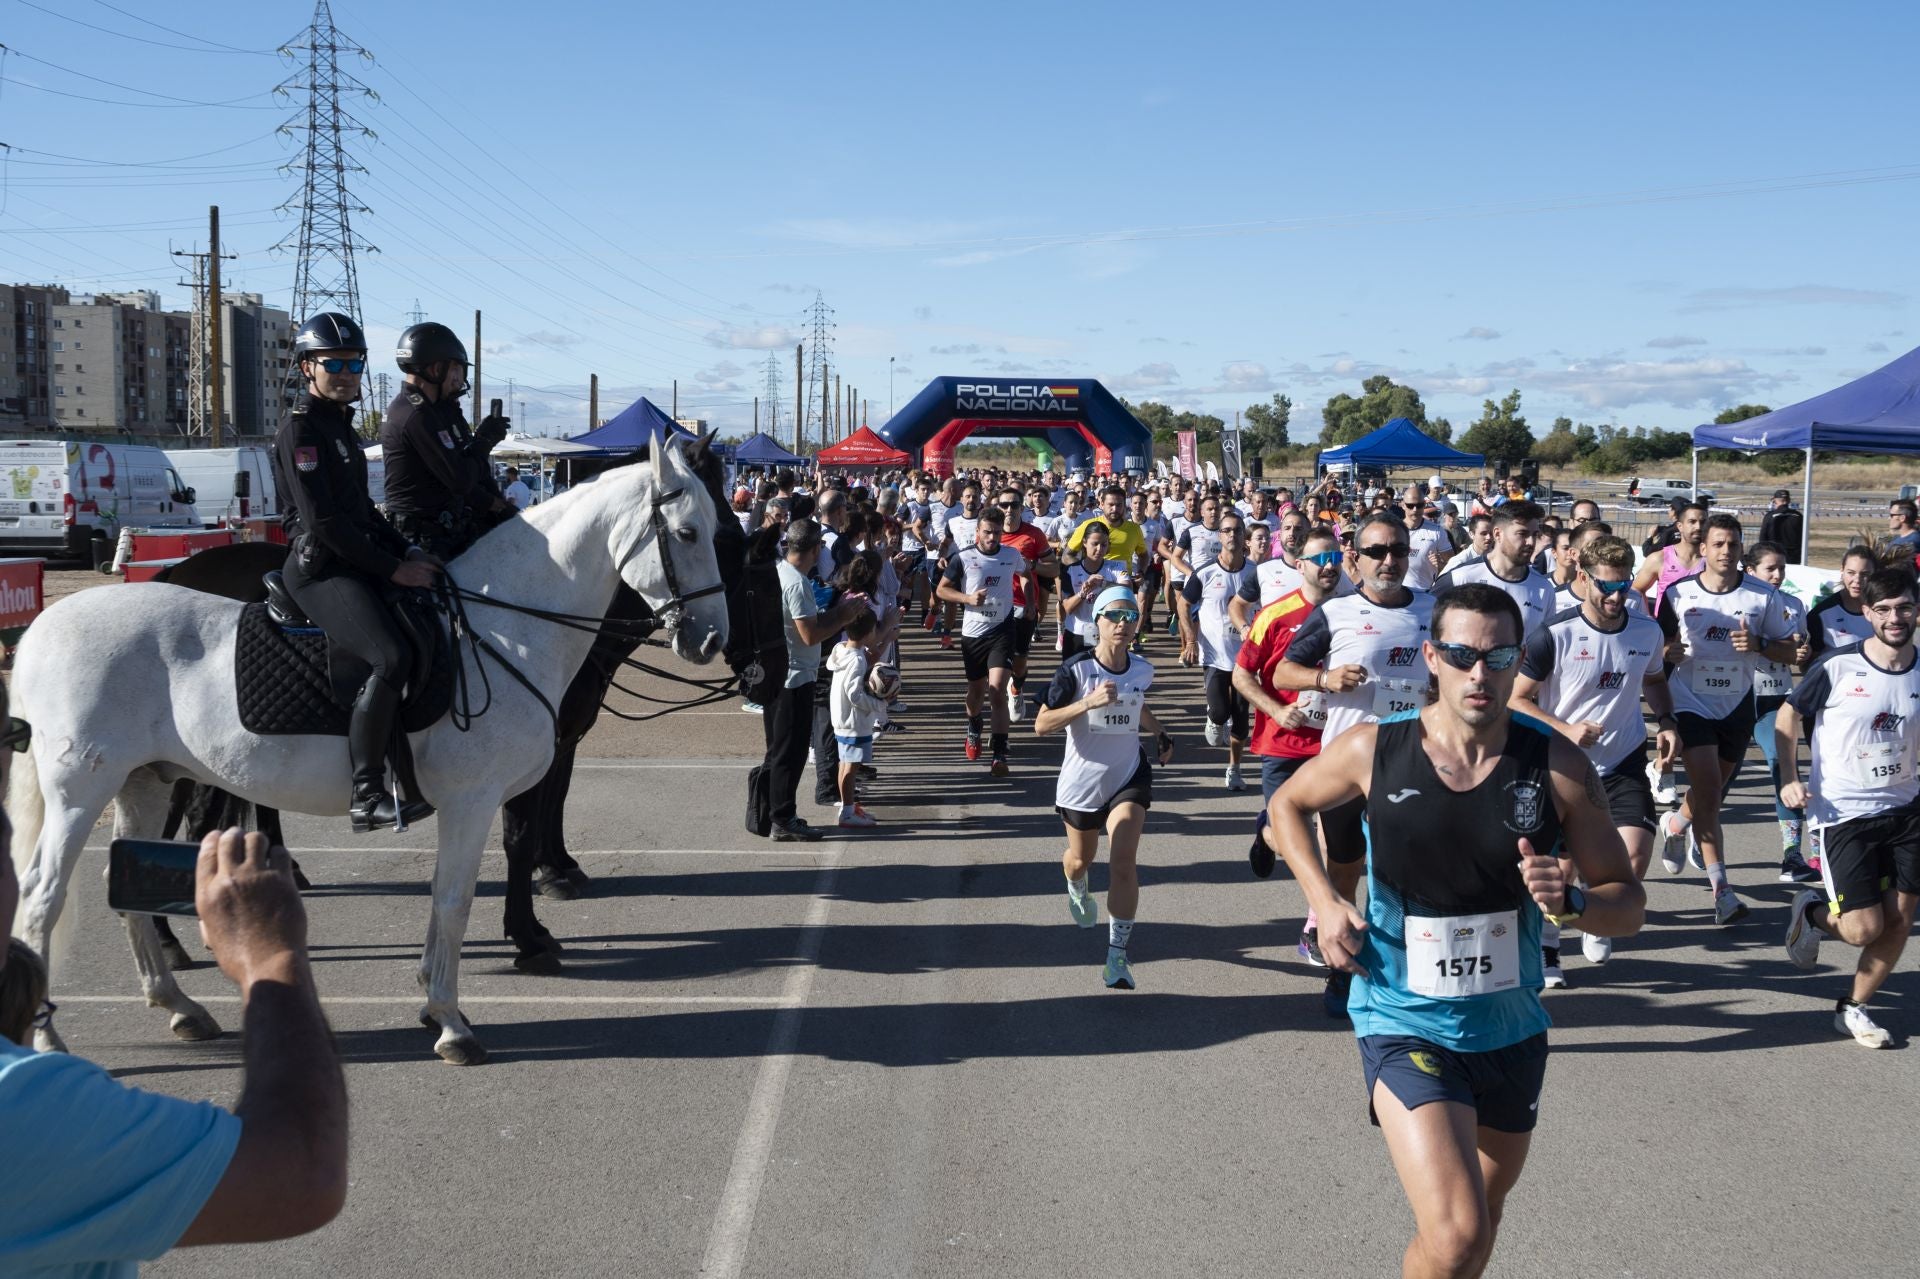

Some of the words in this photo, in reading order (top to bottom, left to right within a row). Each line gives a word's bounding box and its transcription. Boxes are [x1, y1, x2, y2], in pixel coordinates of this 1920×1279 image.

[957, 384, 1054, 397] POLICIA
[957, 398, 1079, 411] NACIONAL
[1124, 455, 1144, 469] RUTA
[1705, 678, 1731, 688] 1399
[1762, 680, 1783, 688] 1134
[1104, 714, 1130, 725] 1180
[1308, 709, 1328, 721] 105
[1872, 763, 1902, 777] 1355
[1436, 955, 1493, 977] 1575
